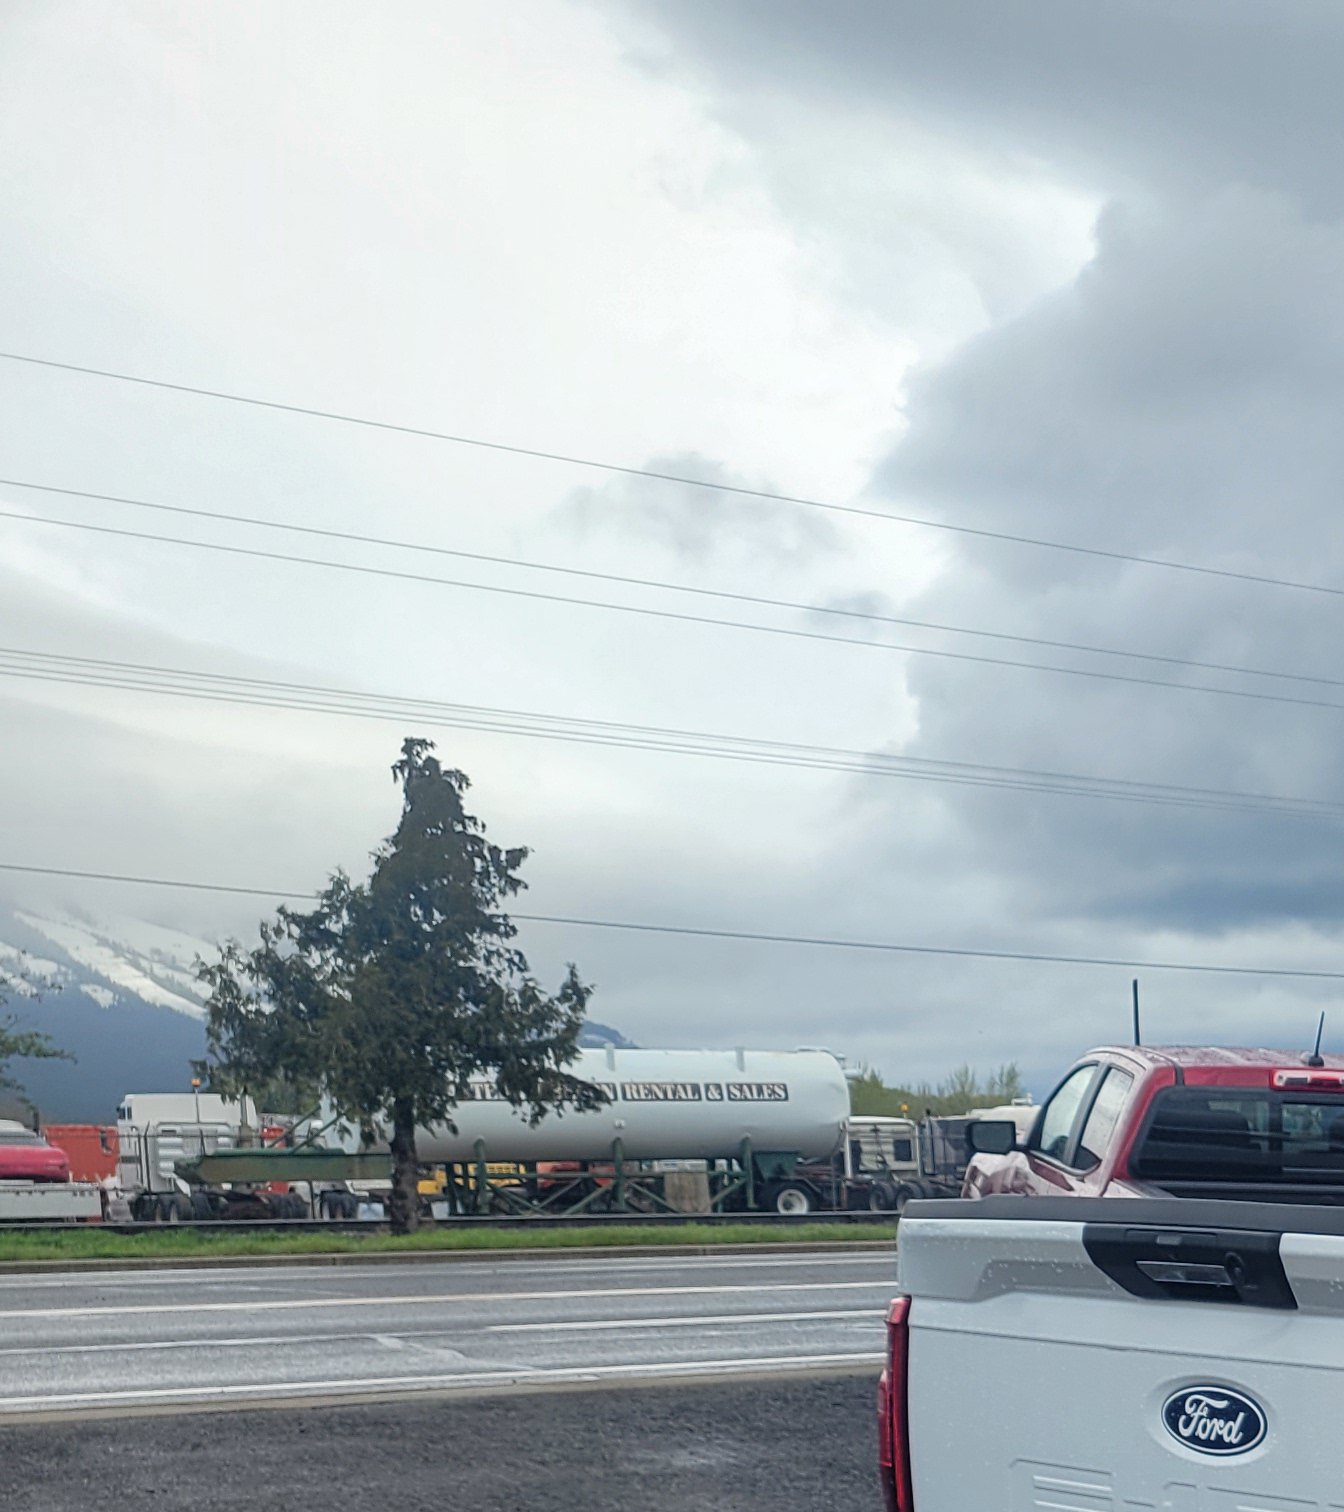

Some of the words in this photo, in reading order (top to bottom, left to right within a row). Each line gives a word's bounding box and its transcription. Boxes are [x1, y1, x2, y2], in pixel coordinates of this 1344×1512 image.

[622, 1083, 700, 1100] RENTAL
[707, 1084, 721, 1100] &
[728, 1083, 786, 1099] SALES
[1178, 1393, 1246, 1445] Ford
